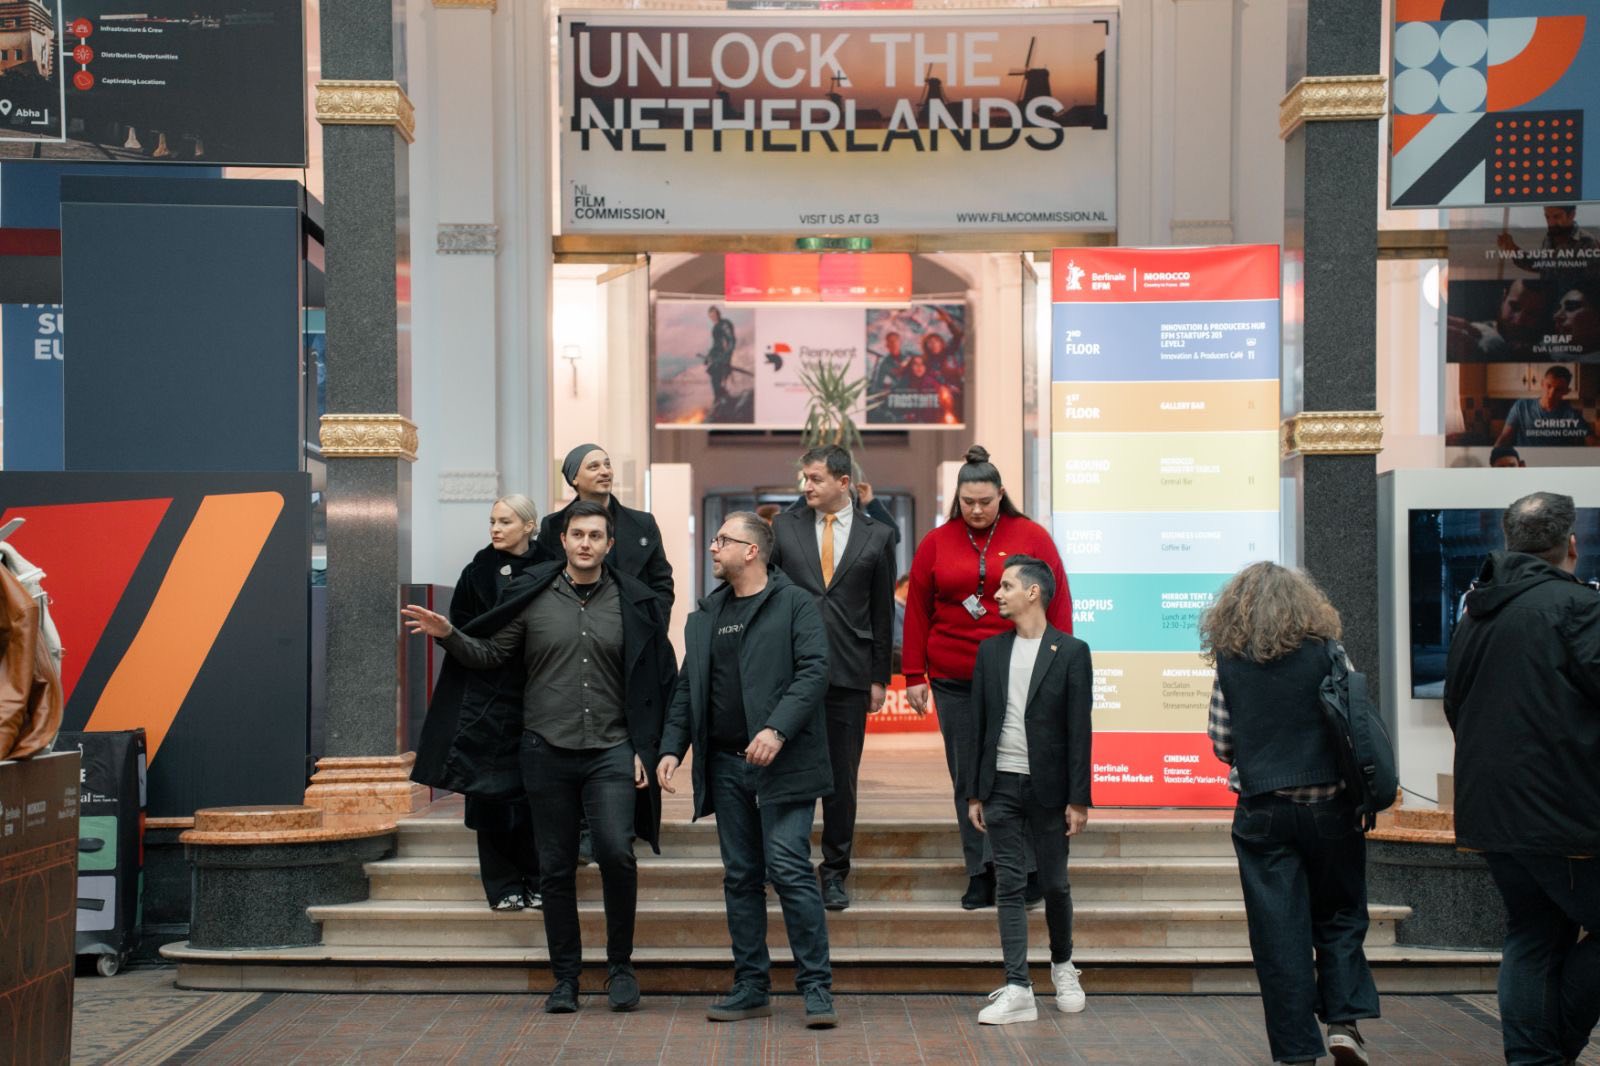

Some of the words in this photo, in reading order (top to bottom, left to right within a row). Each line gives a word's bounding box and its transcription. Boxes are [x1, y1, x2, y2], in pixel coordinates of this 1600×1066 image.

[579, 31, 853, 89] UNLOCK
[869, 31, 1001, 88] THE
[16, 109, 40, 118] Abha
[580, 95, 1066, 152] NETHERLANDS
[574, 185, 591, 196] NL
[574, 196, 606, 208] FILM
[574, 208, 666, 220] COMMISSION
[800, 214, 827, 224] VISIT
[830, 214, 845, 224] US
[848, 214, 861, 224] AT
[864, 214, 880, 224] G3
[956, 211, 1108, 223] WWW.FILMCOMMISSION.NL
[1486, 250, 1496, 259] IT
[1498, 250, 1524, 259] WAS
[1526, 249, 1554, 258] JUST
[1557, 249, 1574, 258] AN
[1092, 272, 1128, 281] Berlinale
[1144, 272, 1190, 281] MOROCCO
[1092, 282, 1112, 290] EFM
[1543, 334, 1573, 344] DEAF
[1066, 344, 1100, 355] FLOOR
[1160, 352, 1193, 360] Innovation
[1200, 352, 1229, 360] Producers
[1066, 407, 1100, 419] FLOOR
[1534, 419, 1580, 428] CHRISTY
[1066, 529, 1103, 540] LOWER
[1066, 543, 1101, 554] FLOOR
[1072, 599, 1113, 610] ROPIUS
[1072, 611, 1094, 622] ARK
[1094, 764, 1128, 772] Berlinale
[1094, 774, 1120, 782] Series
[1122, 774, 1154, 782] Market
